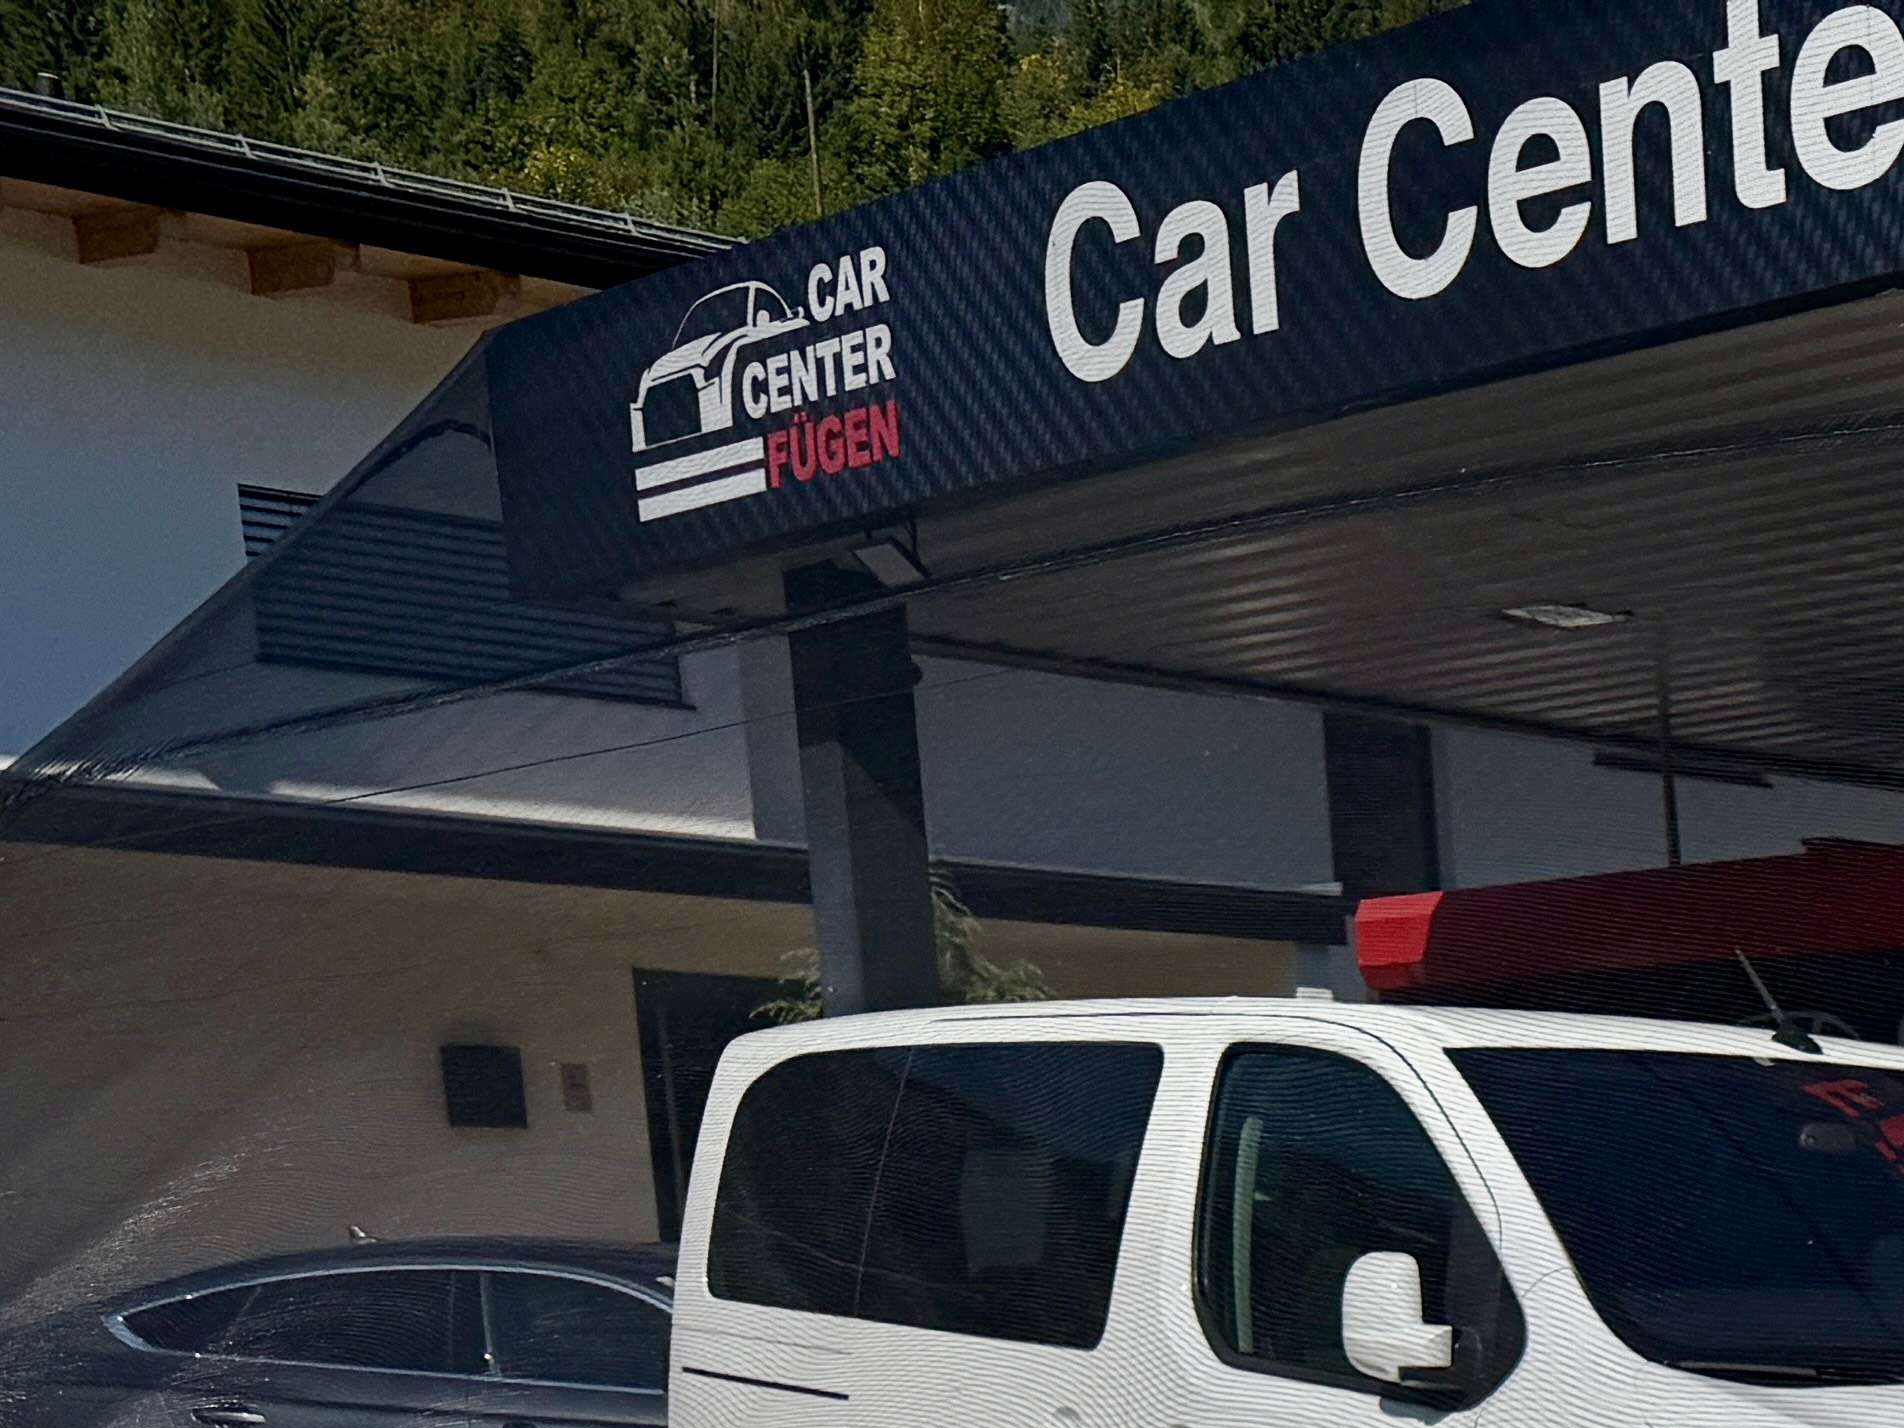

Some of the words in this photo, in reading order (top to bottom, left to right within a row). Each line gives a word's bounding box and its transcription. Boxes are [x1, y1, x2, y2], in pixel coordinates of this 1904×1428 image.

[807, 246, 890, 323] CAR
[1044, 170, 1300, 383] Car
[742, 324, 895, 419] CENTER
[767, 402, 900, 488] FÜGEN
